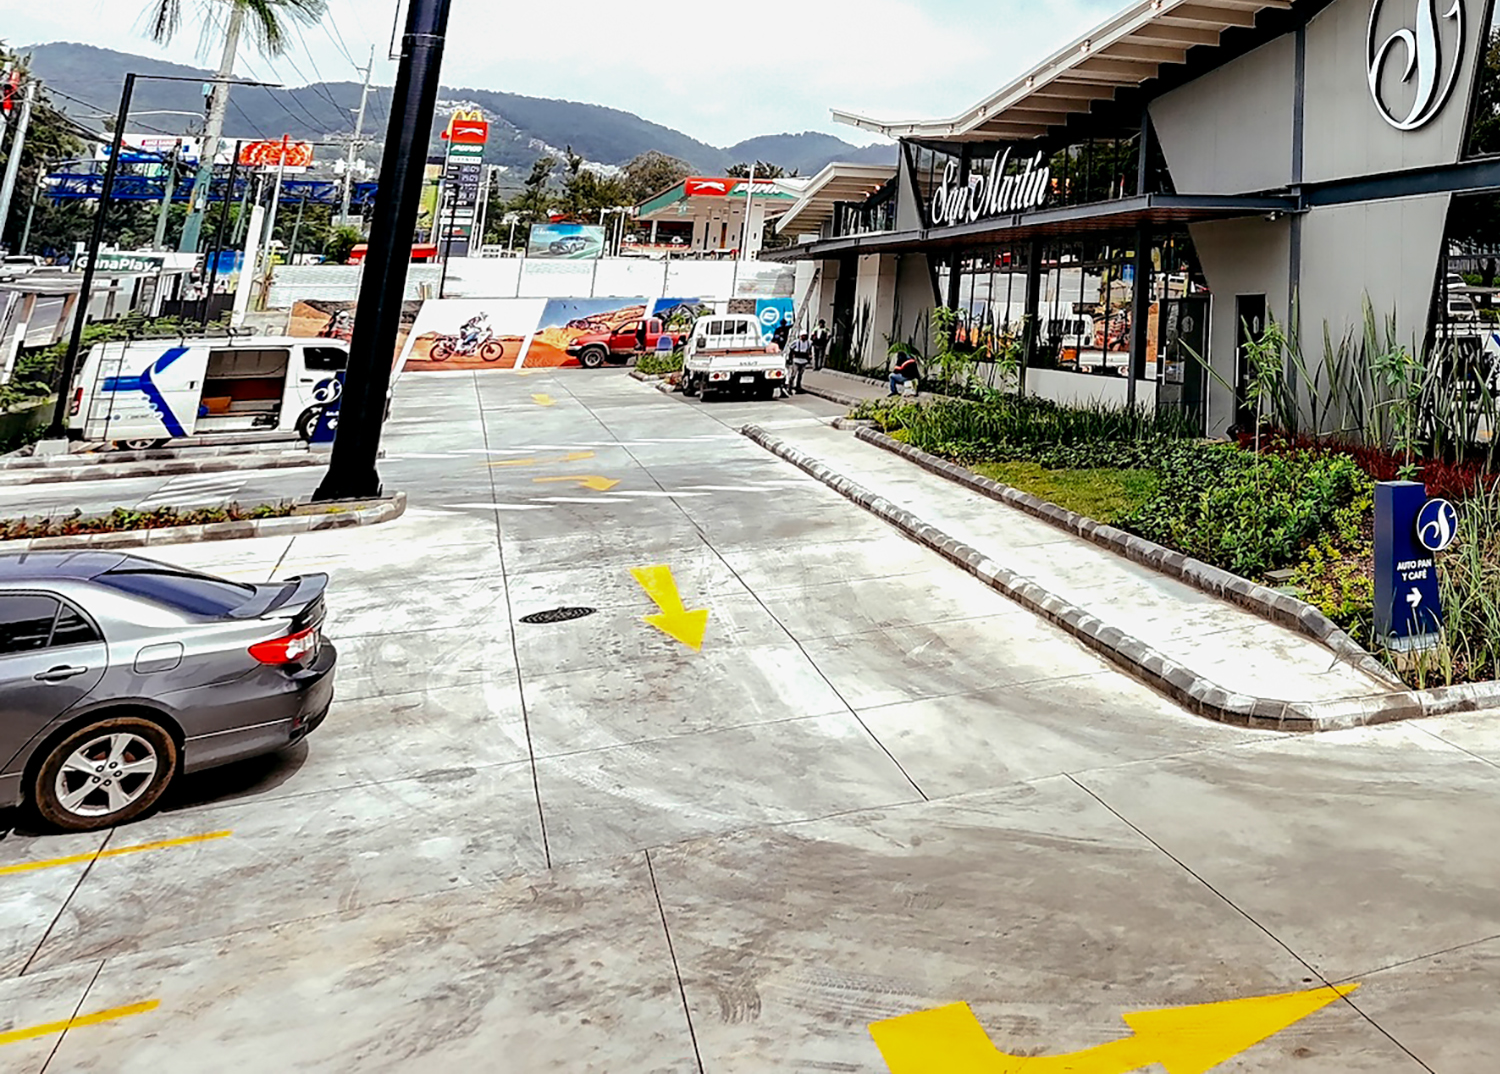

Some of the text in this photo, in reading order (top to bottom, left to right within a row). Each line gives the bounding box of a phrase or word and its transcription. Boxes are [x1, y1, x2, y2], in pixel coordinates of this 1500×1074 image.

[931, 146, 1050, 225] San Martín
[76, 256, 155, 273] GnaPlay
[1396, 558, 1432, 571] AUTO PAN
[1401, 568, 1427, 582] Y CAFÉ
